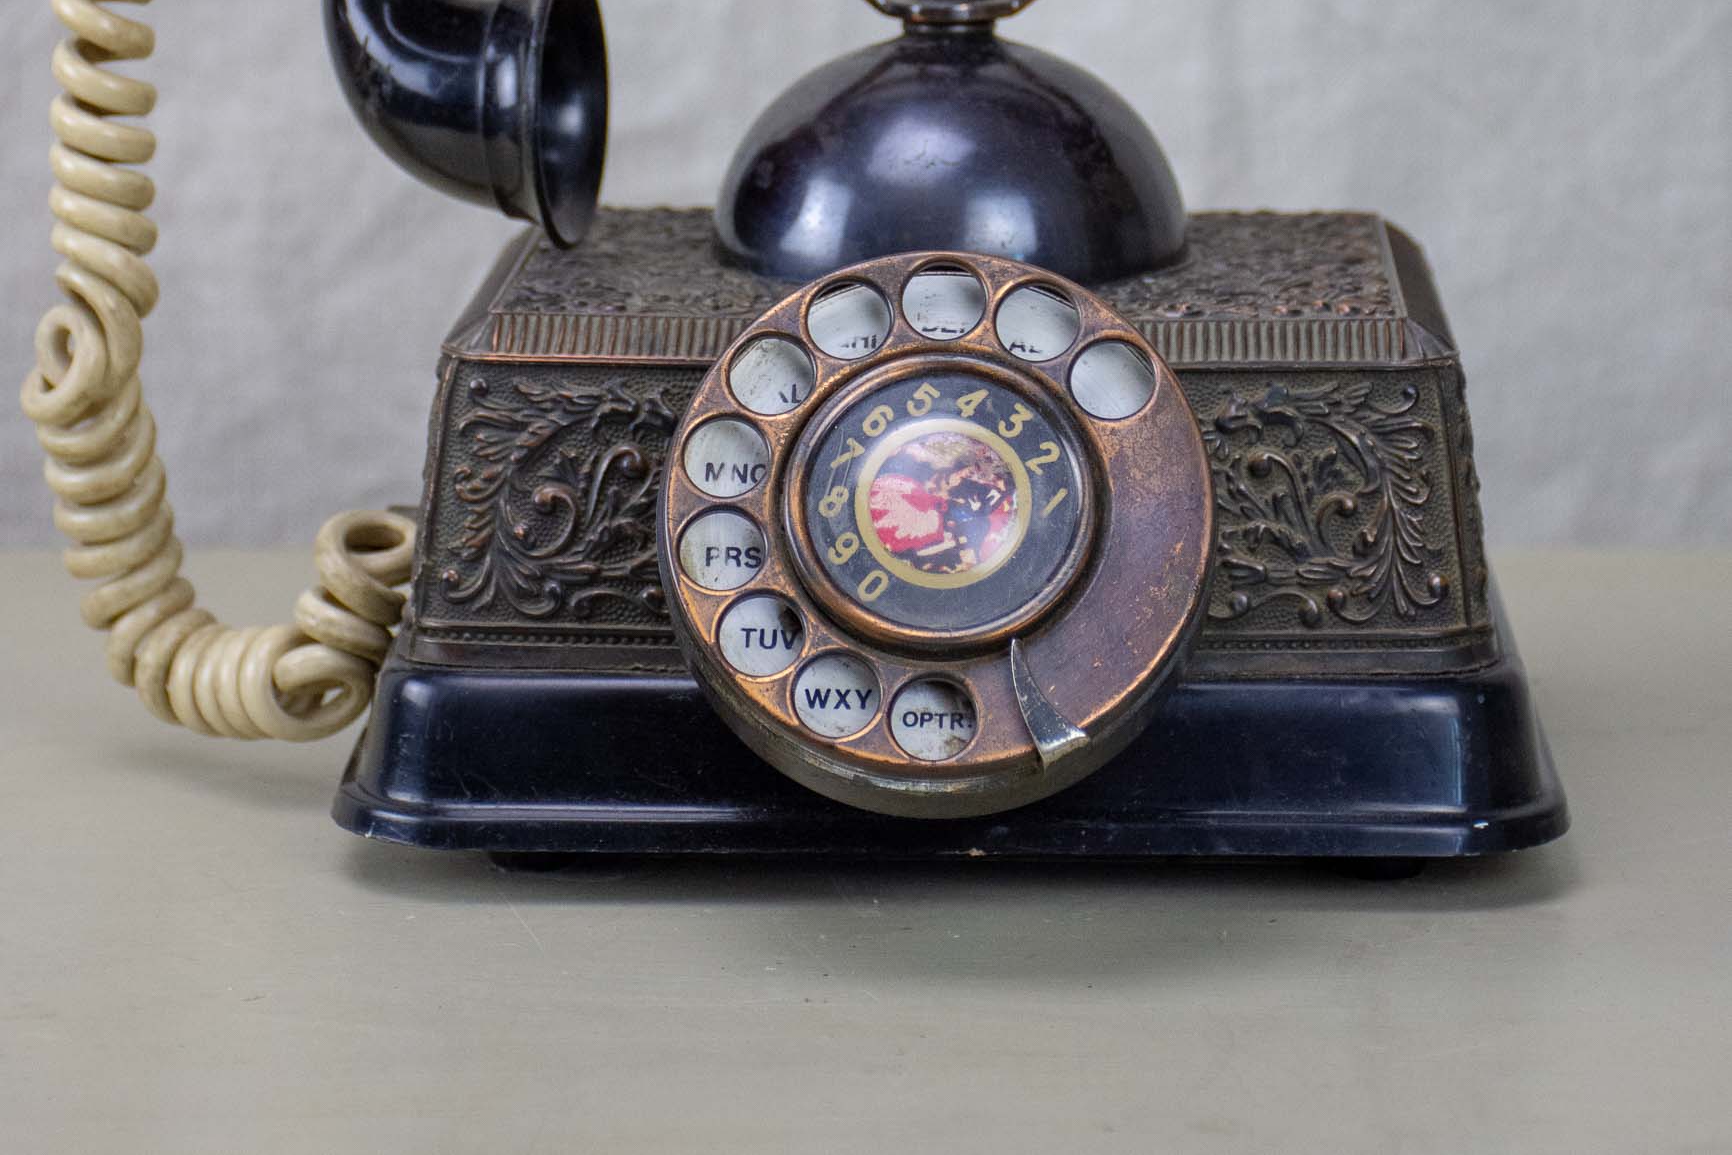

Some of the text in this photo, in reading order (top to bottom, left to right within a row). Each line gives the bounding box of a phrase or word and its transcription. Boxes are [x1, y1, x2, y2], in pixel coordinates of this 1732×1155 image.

[907, 383, 941, 417] 5
[956, 389, 989, 418] 4
[863, 404, 894, 437] 6
[998, 403, 1034, 438] 3
[831, 437, 865, 469] 7
[1025, 440, 1060, 475] 2
[818, 486, 849, 518] 8
[705, 546, 762, 568] PRS
[828, 532, 860, 565] 9
[857, 570, 890, 603] 0
[741, 627, 800, 650] TUV
[804, 688, 872, 710] WXY
